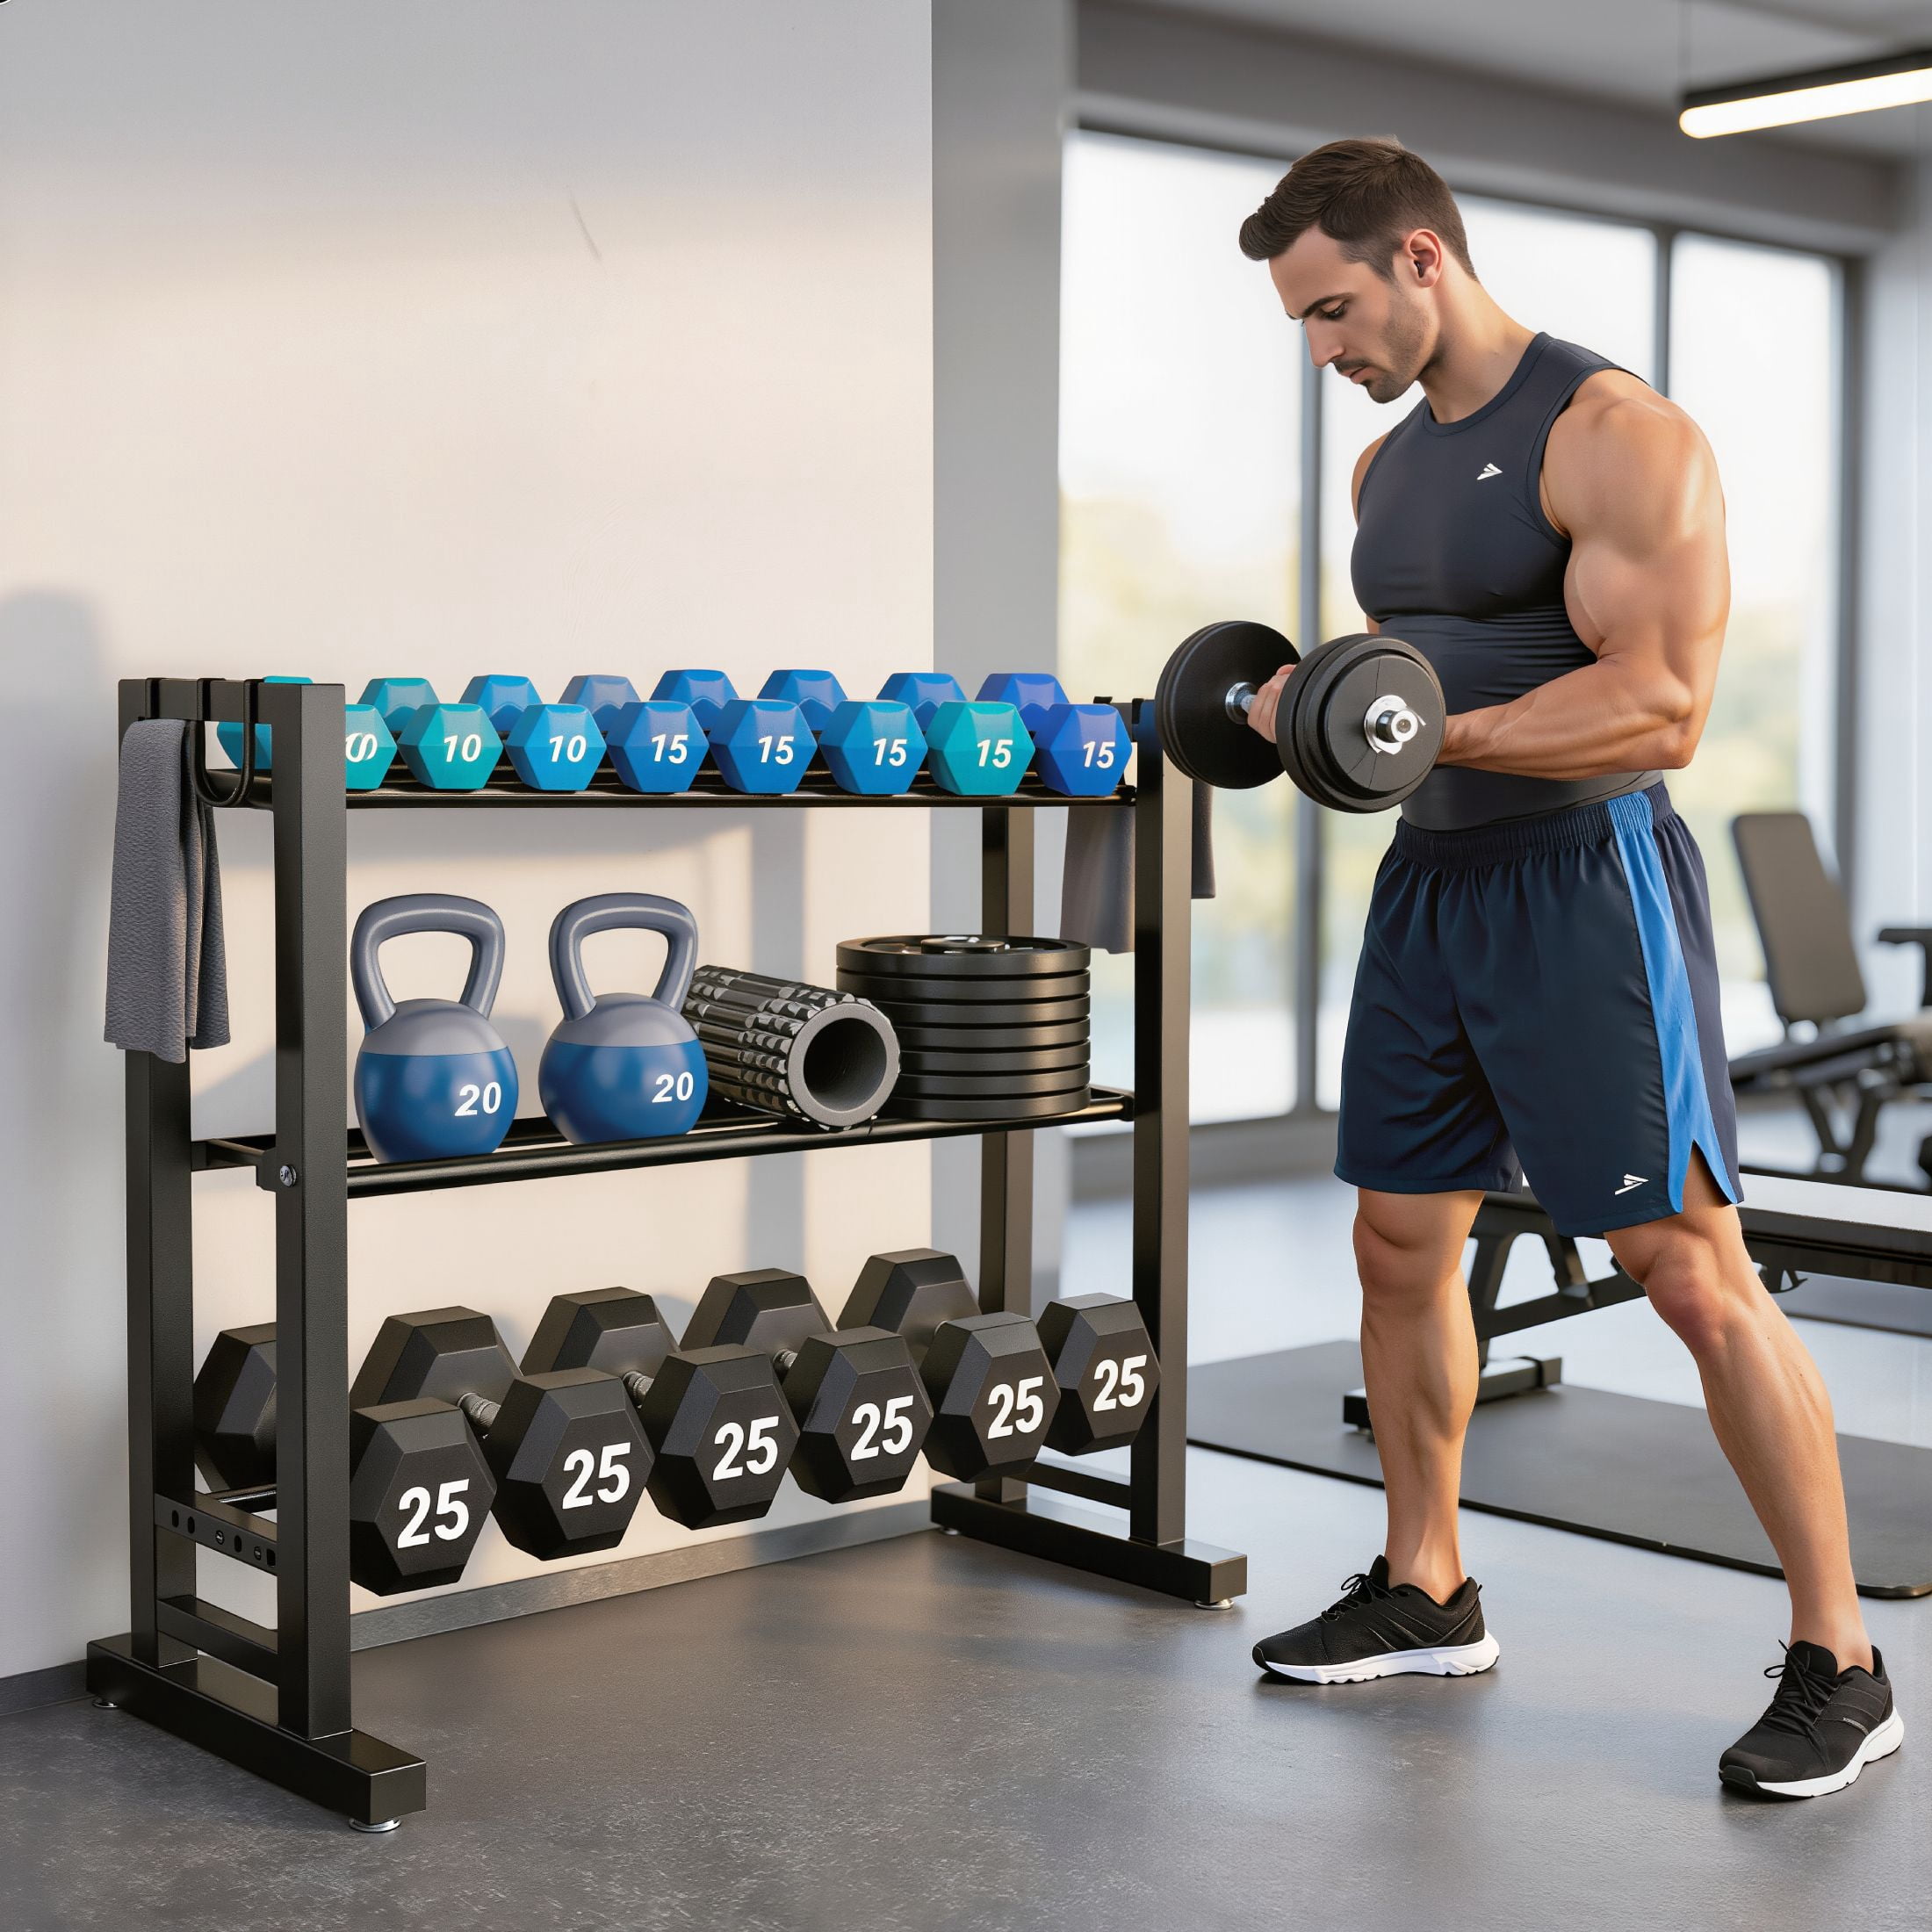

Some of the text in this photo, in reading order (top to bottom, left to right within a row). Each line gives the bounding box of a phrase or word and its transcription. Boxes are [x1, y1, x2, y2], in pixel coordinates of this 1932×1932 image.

[443, 734, 481, 762] 10
[549, 735, 587, 762] 10
[651, 733, 688, 763] 15
[758, 735, 794, 764] 15
[873, 738, 907, 767] 15
[977, 739, 1013, 768] 15
[1083, 741, 1116, 769] 15
[454, 1081, 501, 1117] 20
[652, 1071, 694, 1103] 20
[1092, 1354, 1148, 1412] 25
[987, 1375, 1044, 1439] 25
[850, 1395, 914, 1461] 25
[712, 1416, 780, 1481] 25
[562, 1442, 631, 1510] 25
[397, 1478, 470, 1549] 25
